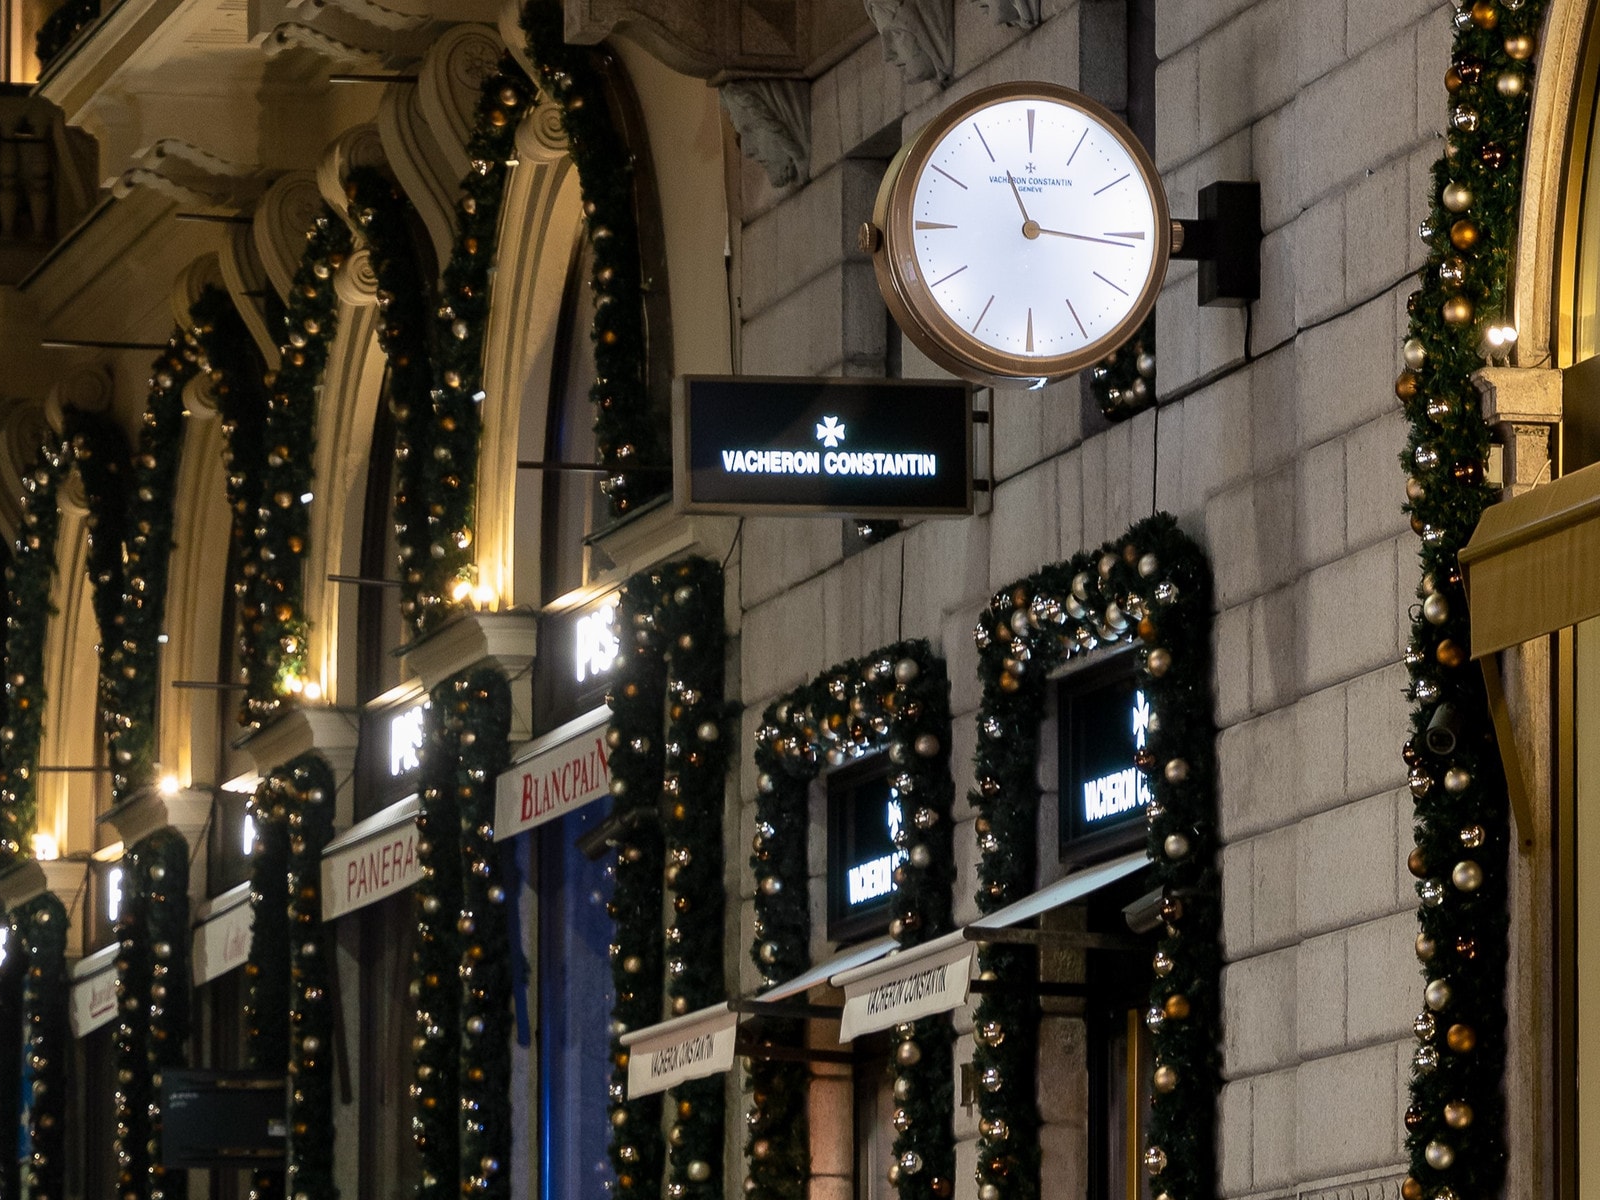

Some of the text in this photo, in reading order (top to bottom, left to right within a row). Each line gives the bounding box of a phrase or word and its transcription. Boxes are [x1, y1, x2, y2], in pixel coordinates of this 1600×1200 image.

[1028, 177, 1073, 187] CONSTANTIN
[721, 450, 936, 476] VACHERON CONSTANTIN
[520, 738, 610, 822] BLANCPAIN
[347, 835, 417, 901] PANERA
